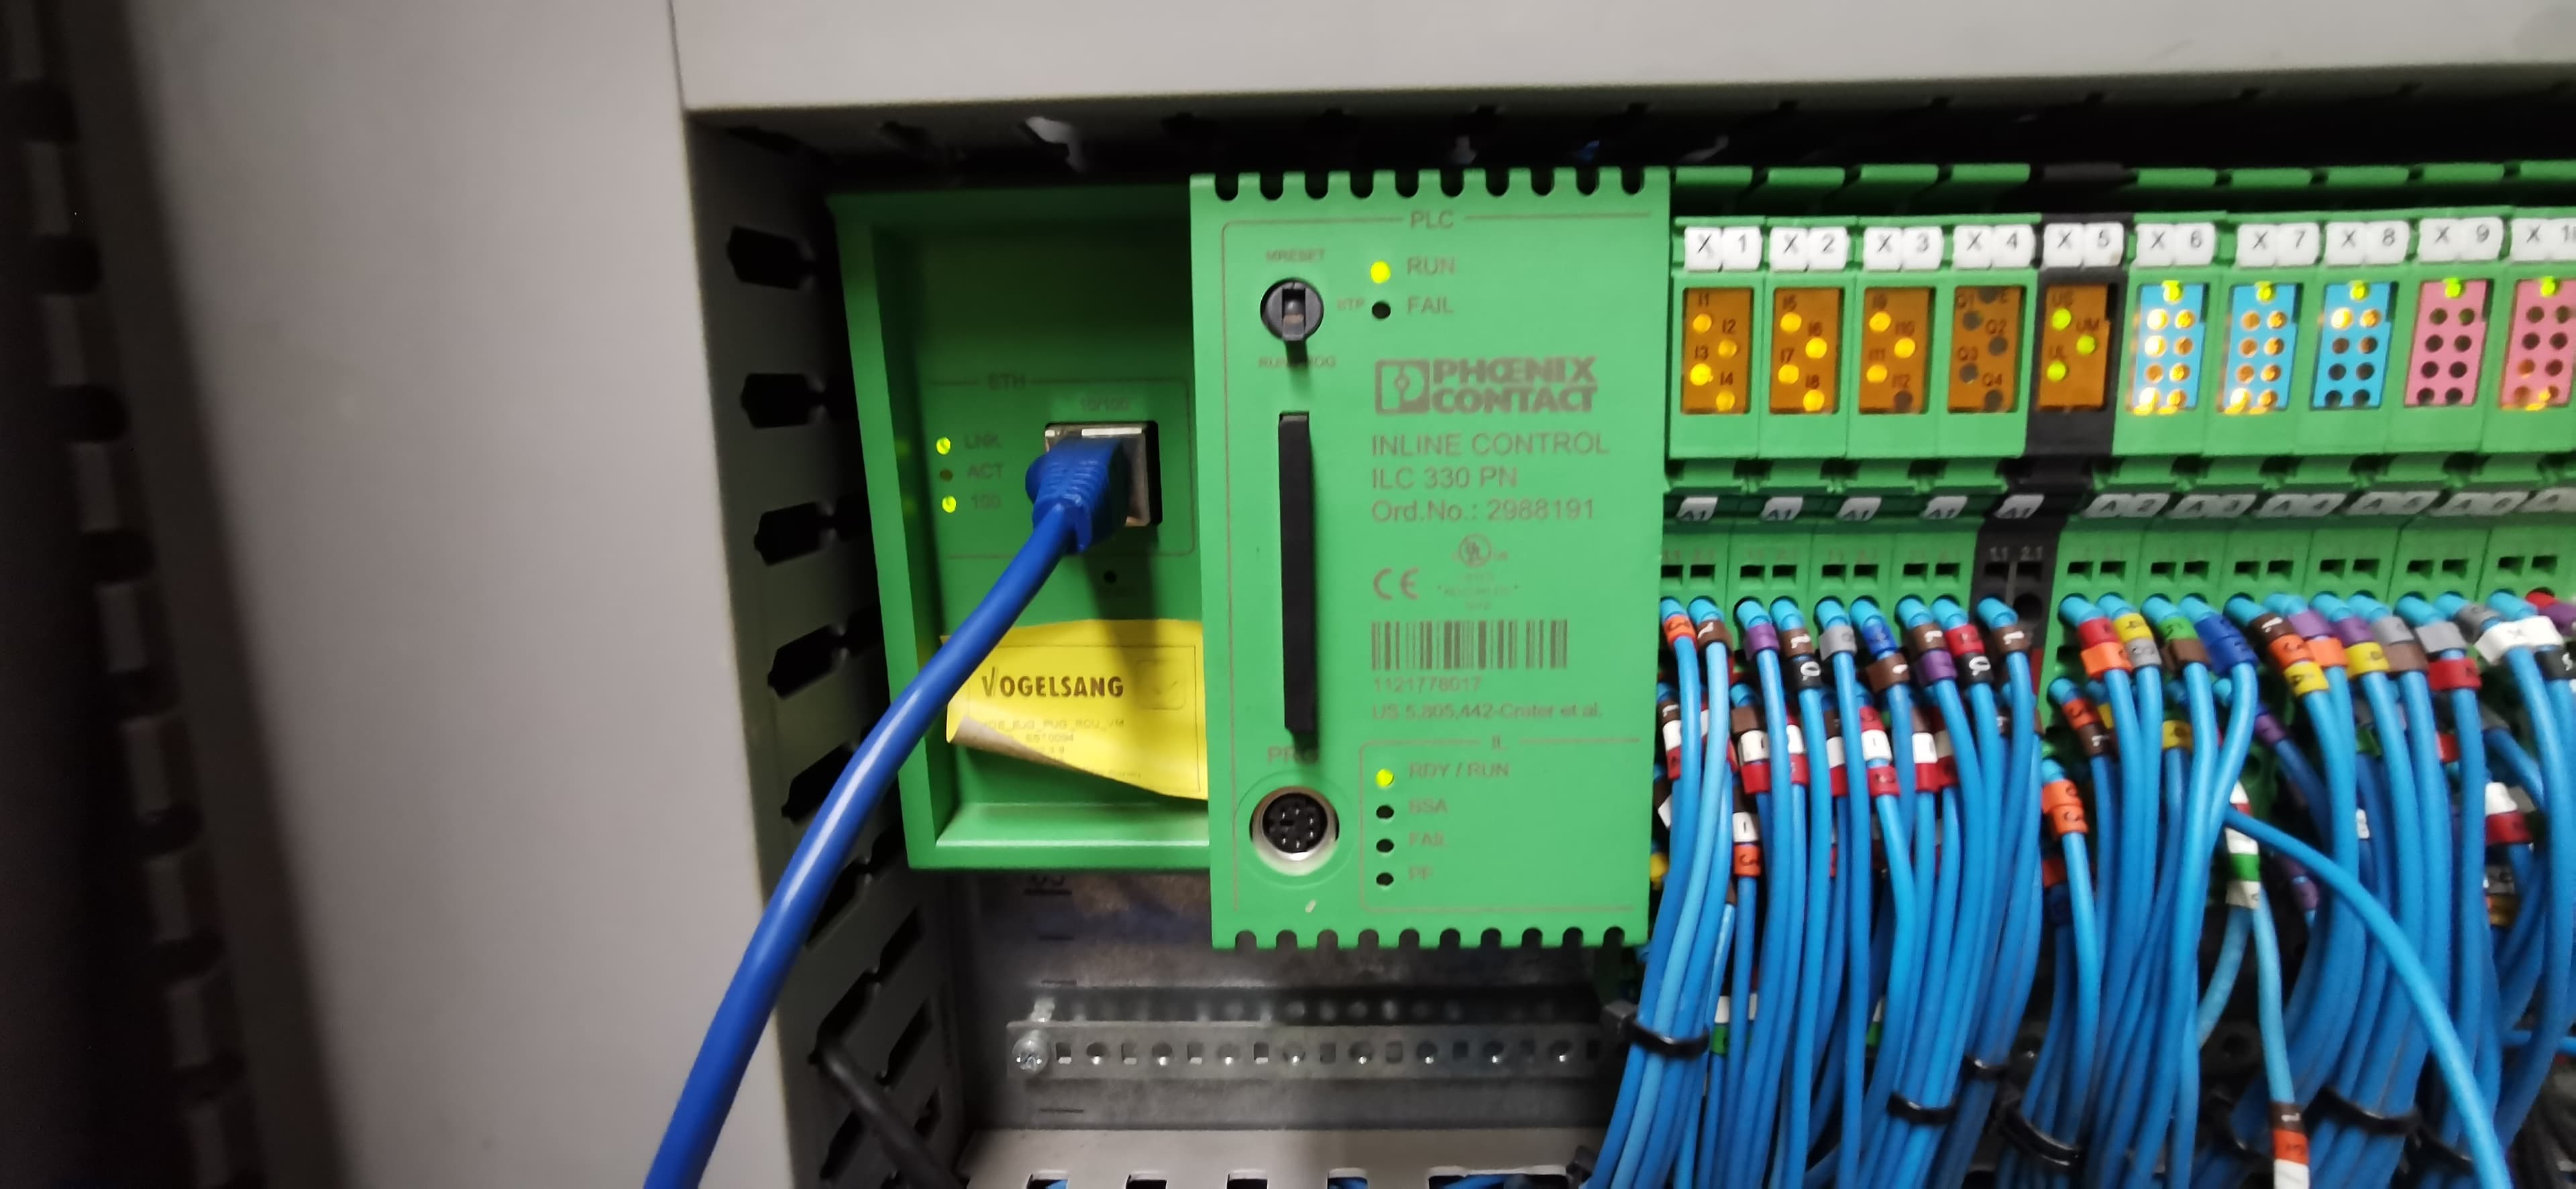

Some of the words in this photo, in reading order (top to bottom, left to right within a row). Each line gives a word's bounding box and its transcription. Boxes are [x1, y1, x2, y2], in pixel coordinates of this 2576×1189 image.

[1411, 211, 1454, 229] PLC
[1783, 233, 1799, 253] X
[1823, 233, 1836, 253] 2
[1877, 233, 1893, 253] X
[1917, 233, 1930, 252] 3
[1967, 232, 1984, 251] X
[2006, 232, 2019, 250] 4
[2057, 231, 2072, 248] X
[2096, 230, 2110, 247] 5
[2150, 231, 2165, 249] X
[2190, 230, 2203, 248] 6
[2253, 231, 2268, 249] X
[2294, 231, 2306, 249] 7
[2341, 229, 2357, 247] X
[2382, 227, 2396, 247] 8
[2435, 225, 2451, 244] X
[2475, 225, 2490, 243] 9
[2526, 225, 2542, 243] X
[1697, 234, 1715, 255] X
[1738, 235, 1748, 253] 1
[1407, 257, 1456, 274] RUN
[1407, 296, 1454, 314] FAIL
[987, 374, 1026, 391] ETH
[1432, 386, 1599, 414] CONTACT
[1372, 433, 1462, 457] INLINE
[1471, 431, 1610, 455] CONTROL
[967, 463, 1004, 480] ACT
[1372, 466, 1415, 490] ILC
[1424, 465, 1470, 489] 330
[1479, 465, 1519, 489] PN
[1372, 499, 1478, 522] Ord.No.:
[1487, 498, 1595, 522] 2988191
[2020, 545, 2043, 562] 2.1
[981, 666, 1124, 699] VOGELSANG
[1373, 703, 1399, 720] US
[1560, 703, 1578, 719] et
[1409, 762, 1450, 779] RDY
[1466, 762, 1510, 778] RUN
[1408, 799, 1448, 815] BSA
[1408, 832, 1445, 848] FAIL
[1408, 866, 1433, 882] PF
